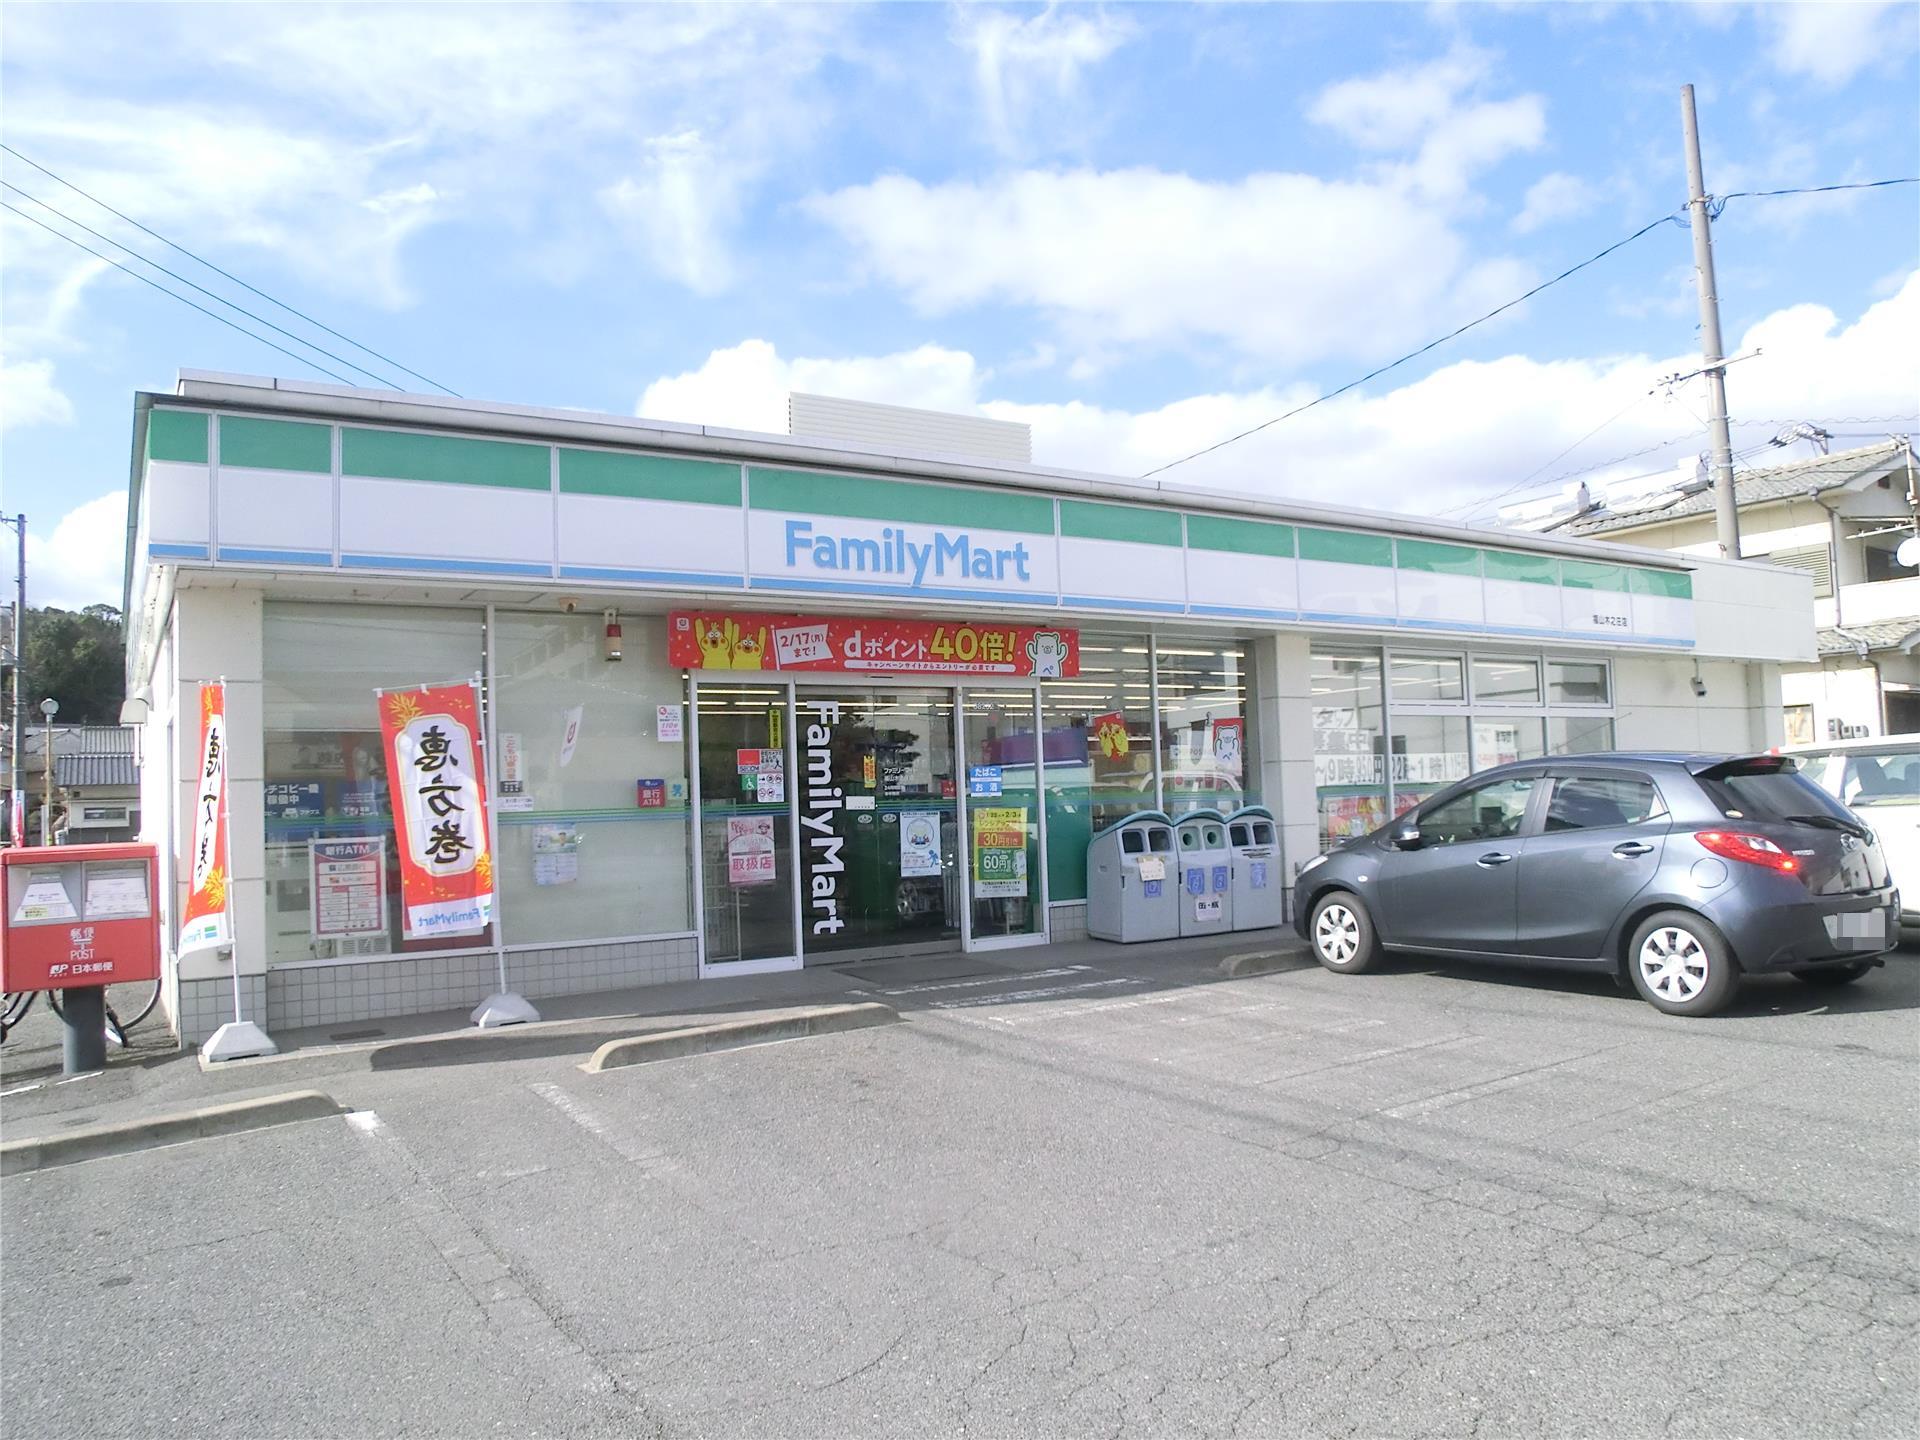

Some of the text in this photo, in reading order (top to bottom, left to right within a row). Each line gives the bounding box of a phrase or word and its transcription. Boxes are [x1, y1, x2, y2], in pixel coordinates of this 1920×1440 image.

[785, 519, 1030, 588] FamilyMart
[974, 767, 997, 777] たばこ
[643, 798, 661, 806] ATM
[801, 701, 845, 935] FamilyMart
[325, 845, 370, 856] 銀行ATM
[732, 856, 773, 870] 取扱店
[70, 949, 94, 960] POST
[72, 962, 113, 974] 日本郵便
